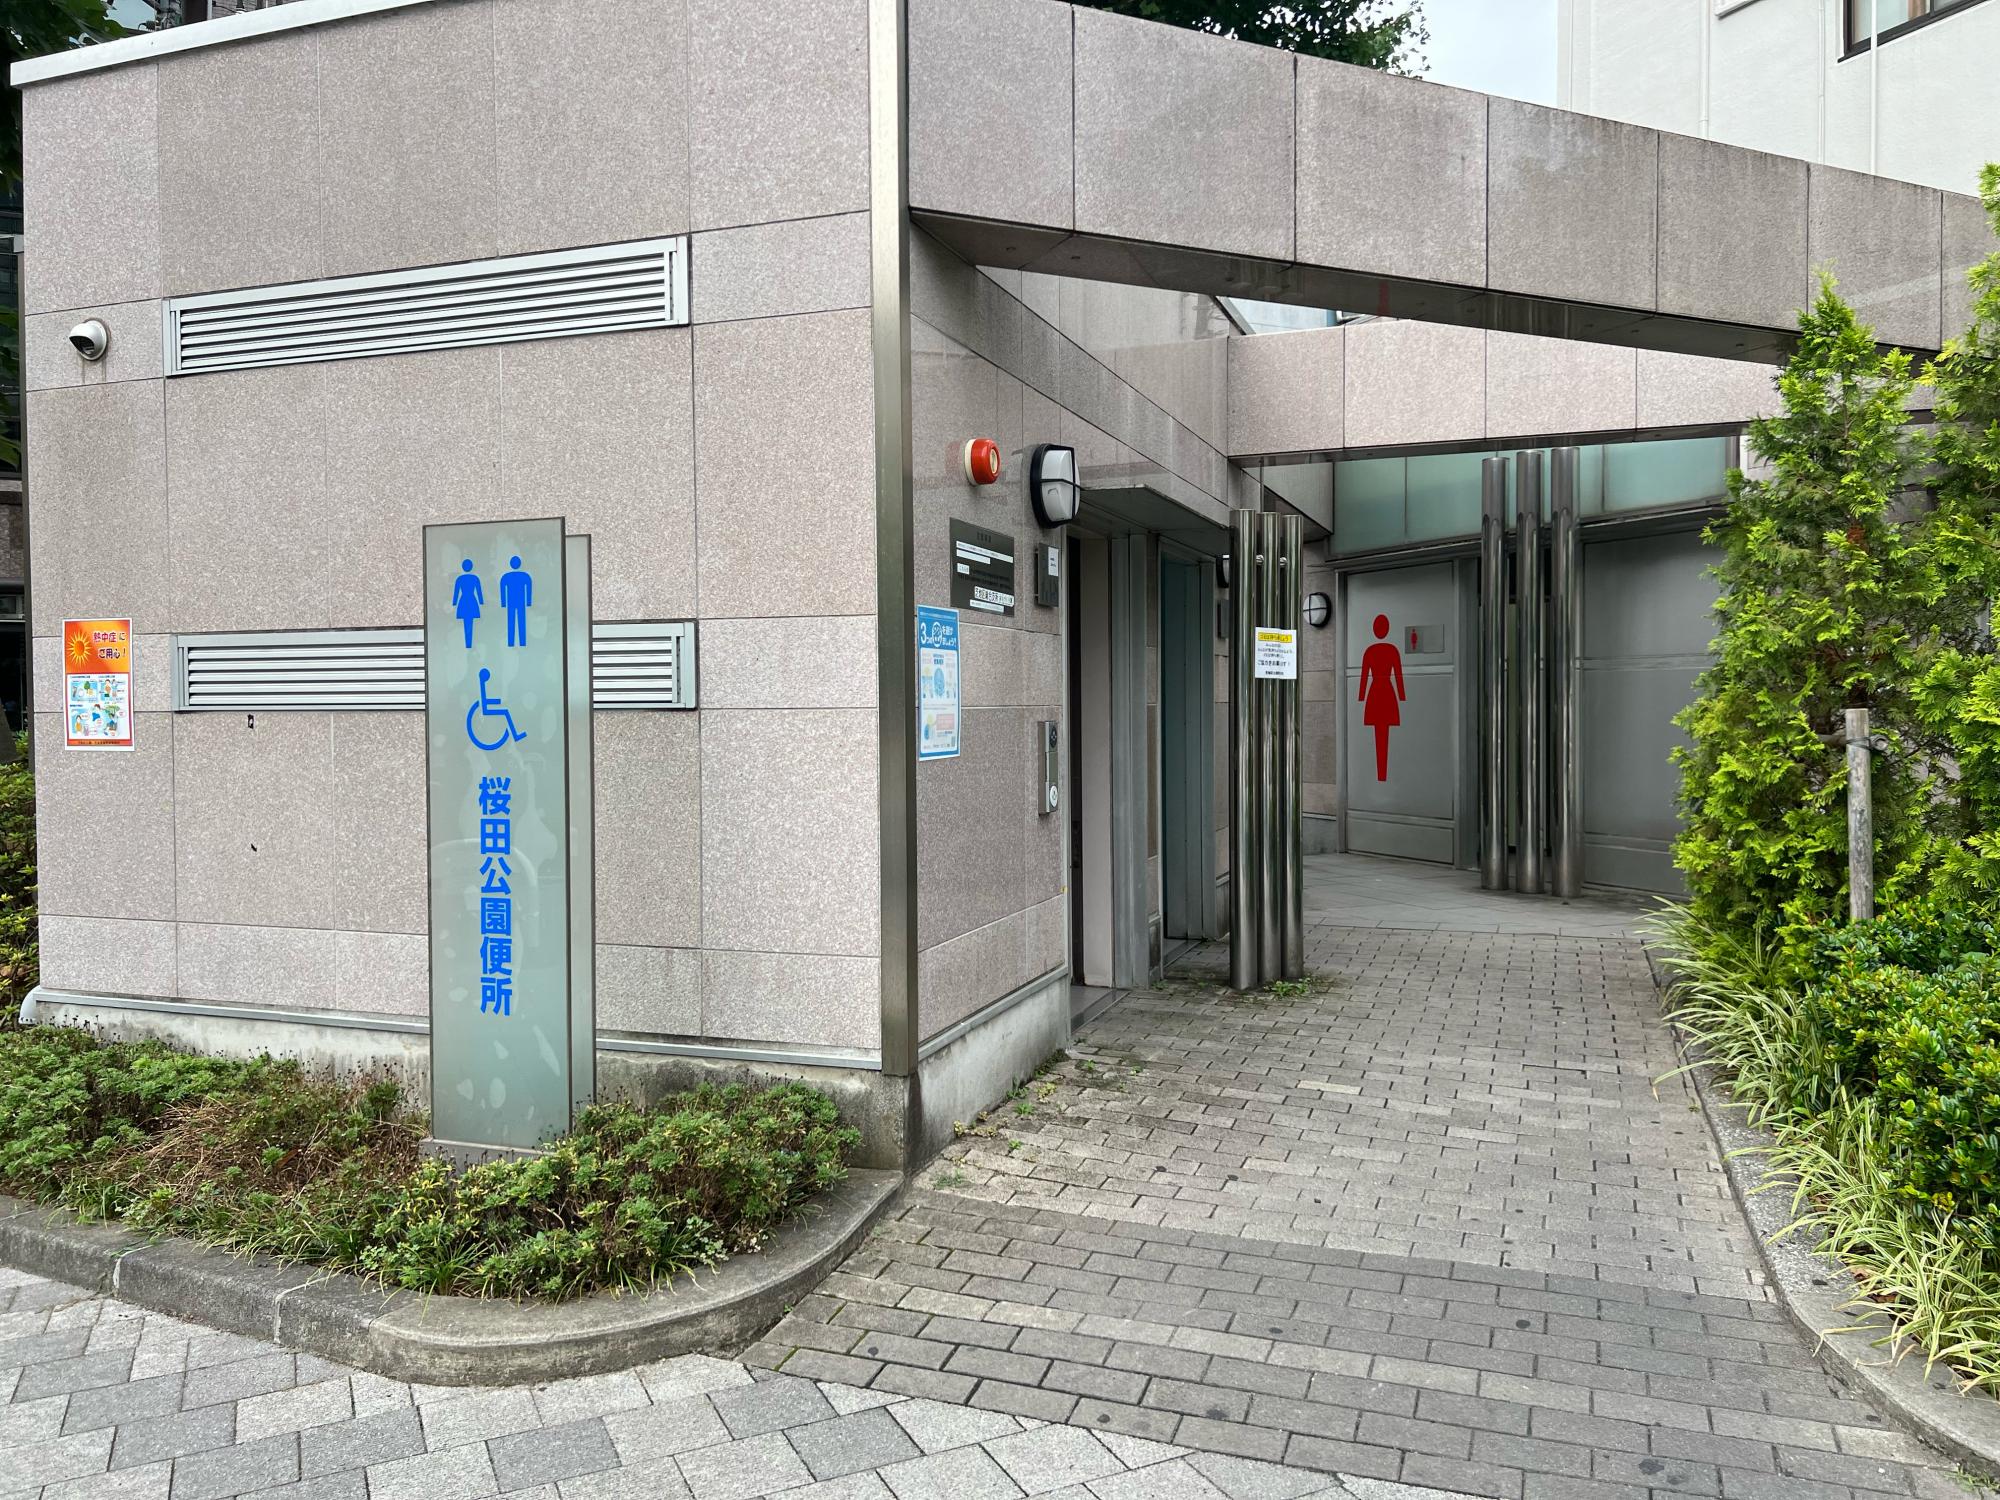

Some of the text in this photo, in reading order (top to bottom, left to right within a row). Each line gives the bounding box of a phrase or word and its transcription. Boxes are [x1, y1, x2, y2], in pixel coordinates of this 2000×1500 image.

[93, 631, 126, 643] 熱中症に
[478, 776, 513, 1017] 桜田公園便所
